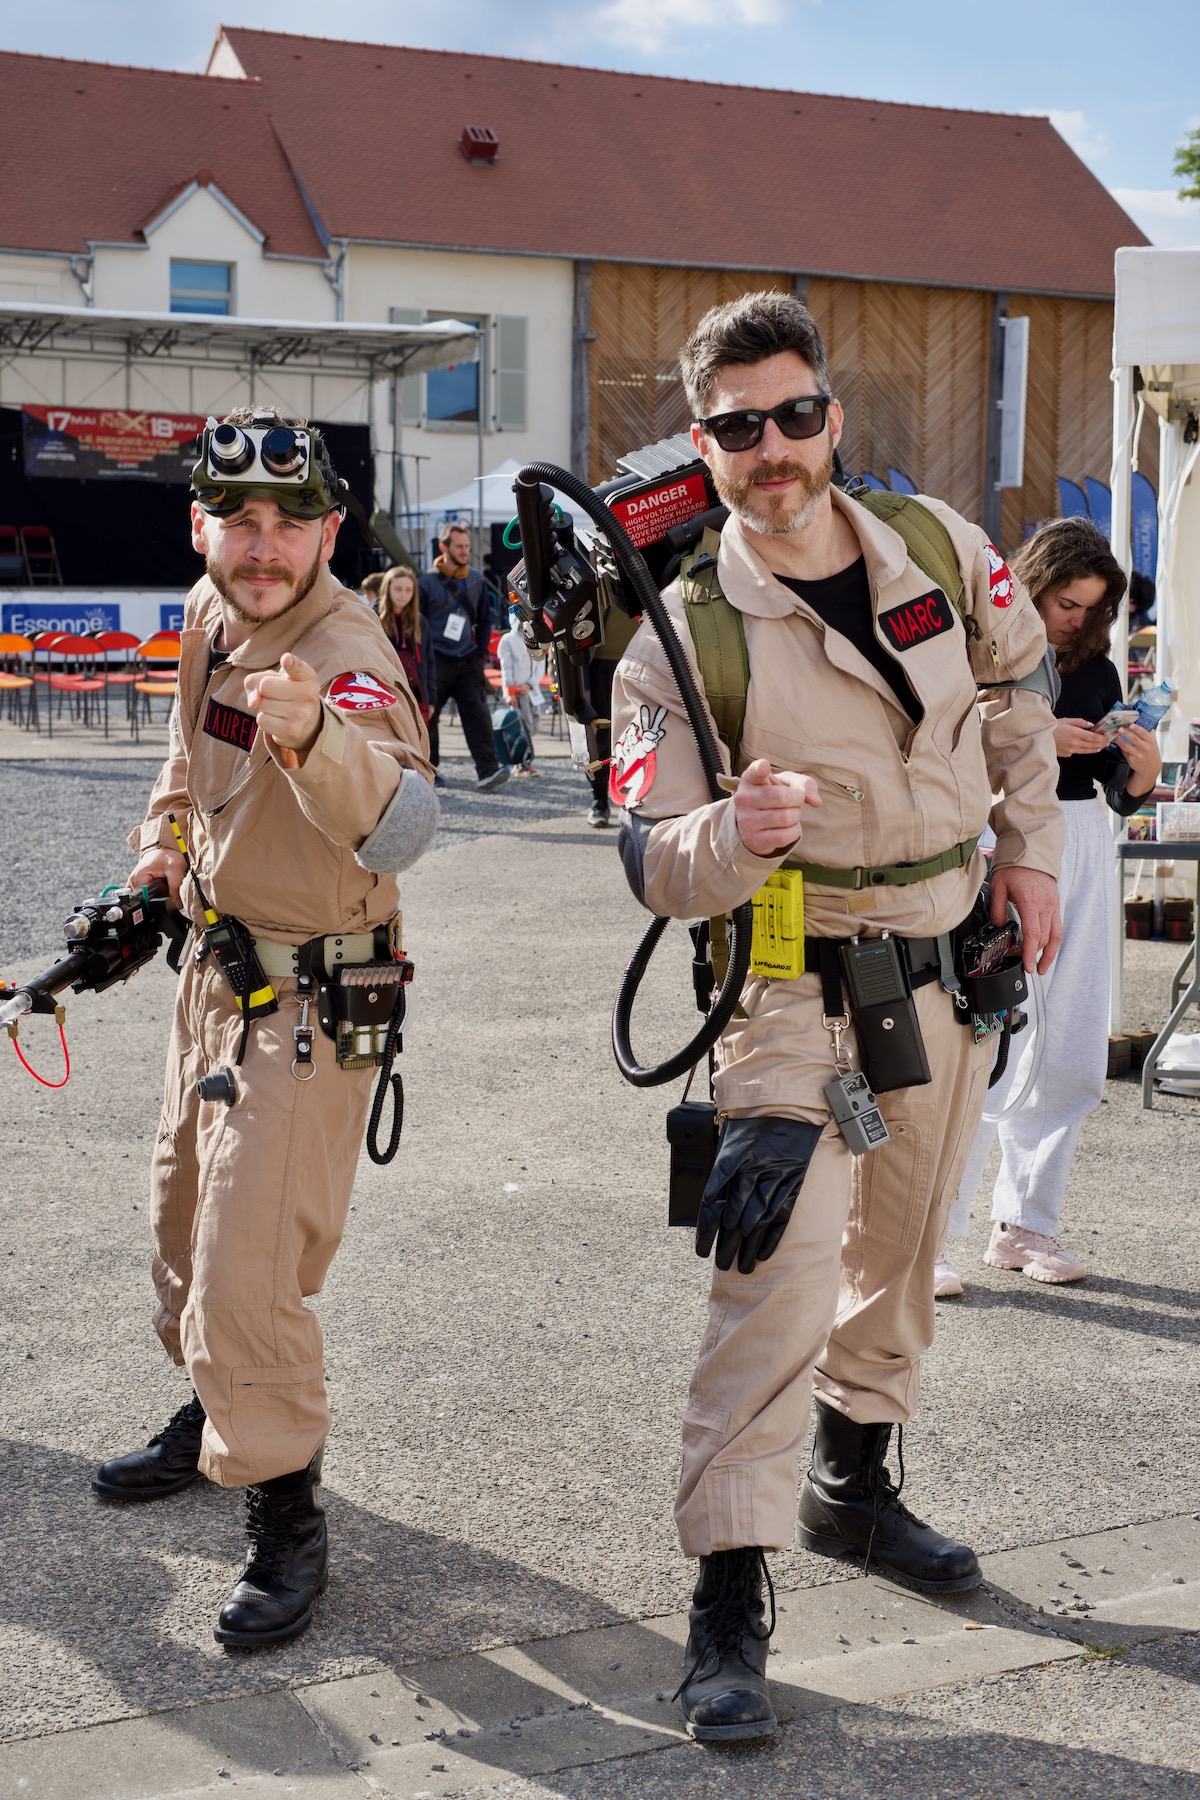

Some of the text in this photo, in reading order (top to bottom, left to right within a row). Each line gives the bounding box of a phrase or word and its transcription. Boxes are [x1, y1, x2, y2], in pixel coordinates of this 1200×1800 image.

[47, 411, 96, 432] 17 MAI
[151, 417, 197, 438] 18 MAI
[96, 435, 180, 449] RENDEZ-VOUS
[627, 484, 688, 516] DANGER
[625, 516, 644, 528] HIGH
[644, 503, 678, 521] VOLTAGE
[625, 500, 706, 535] CTRIC SHOCK HAZARD
[628, 509, 704, 541] MOVE POWER BEFORE
[646, 532, 658, 543] OR
[11, 613, 104, 635] Essonne
[887, 597, 943, 646] MARC
[754, 960, 785, 970] LIFEGARD
